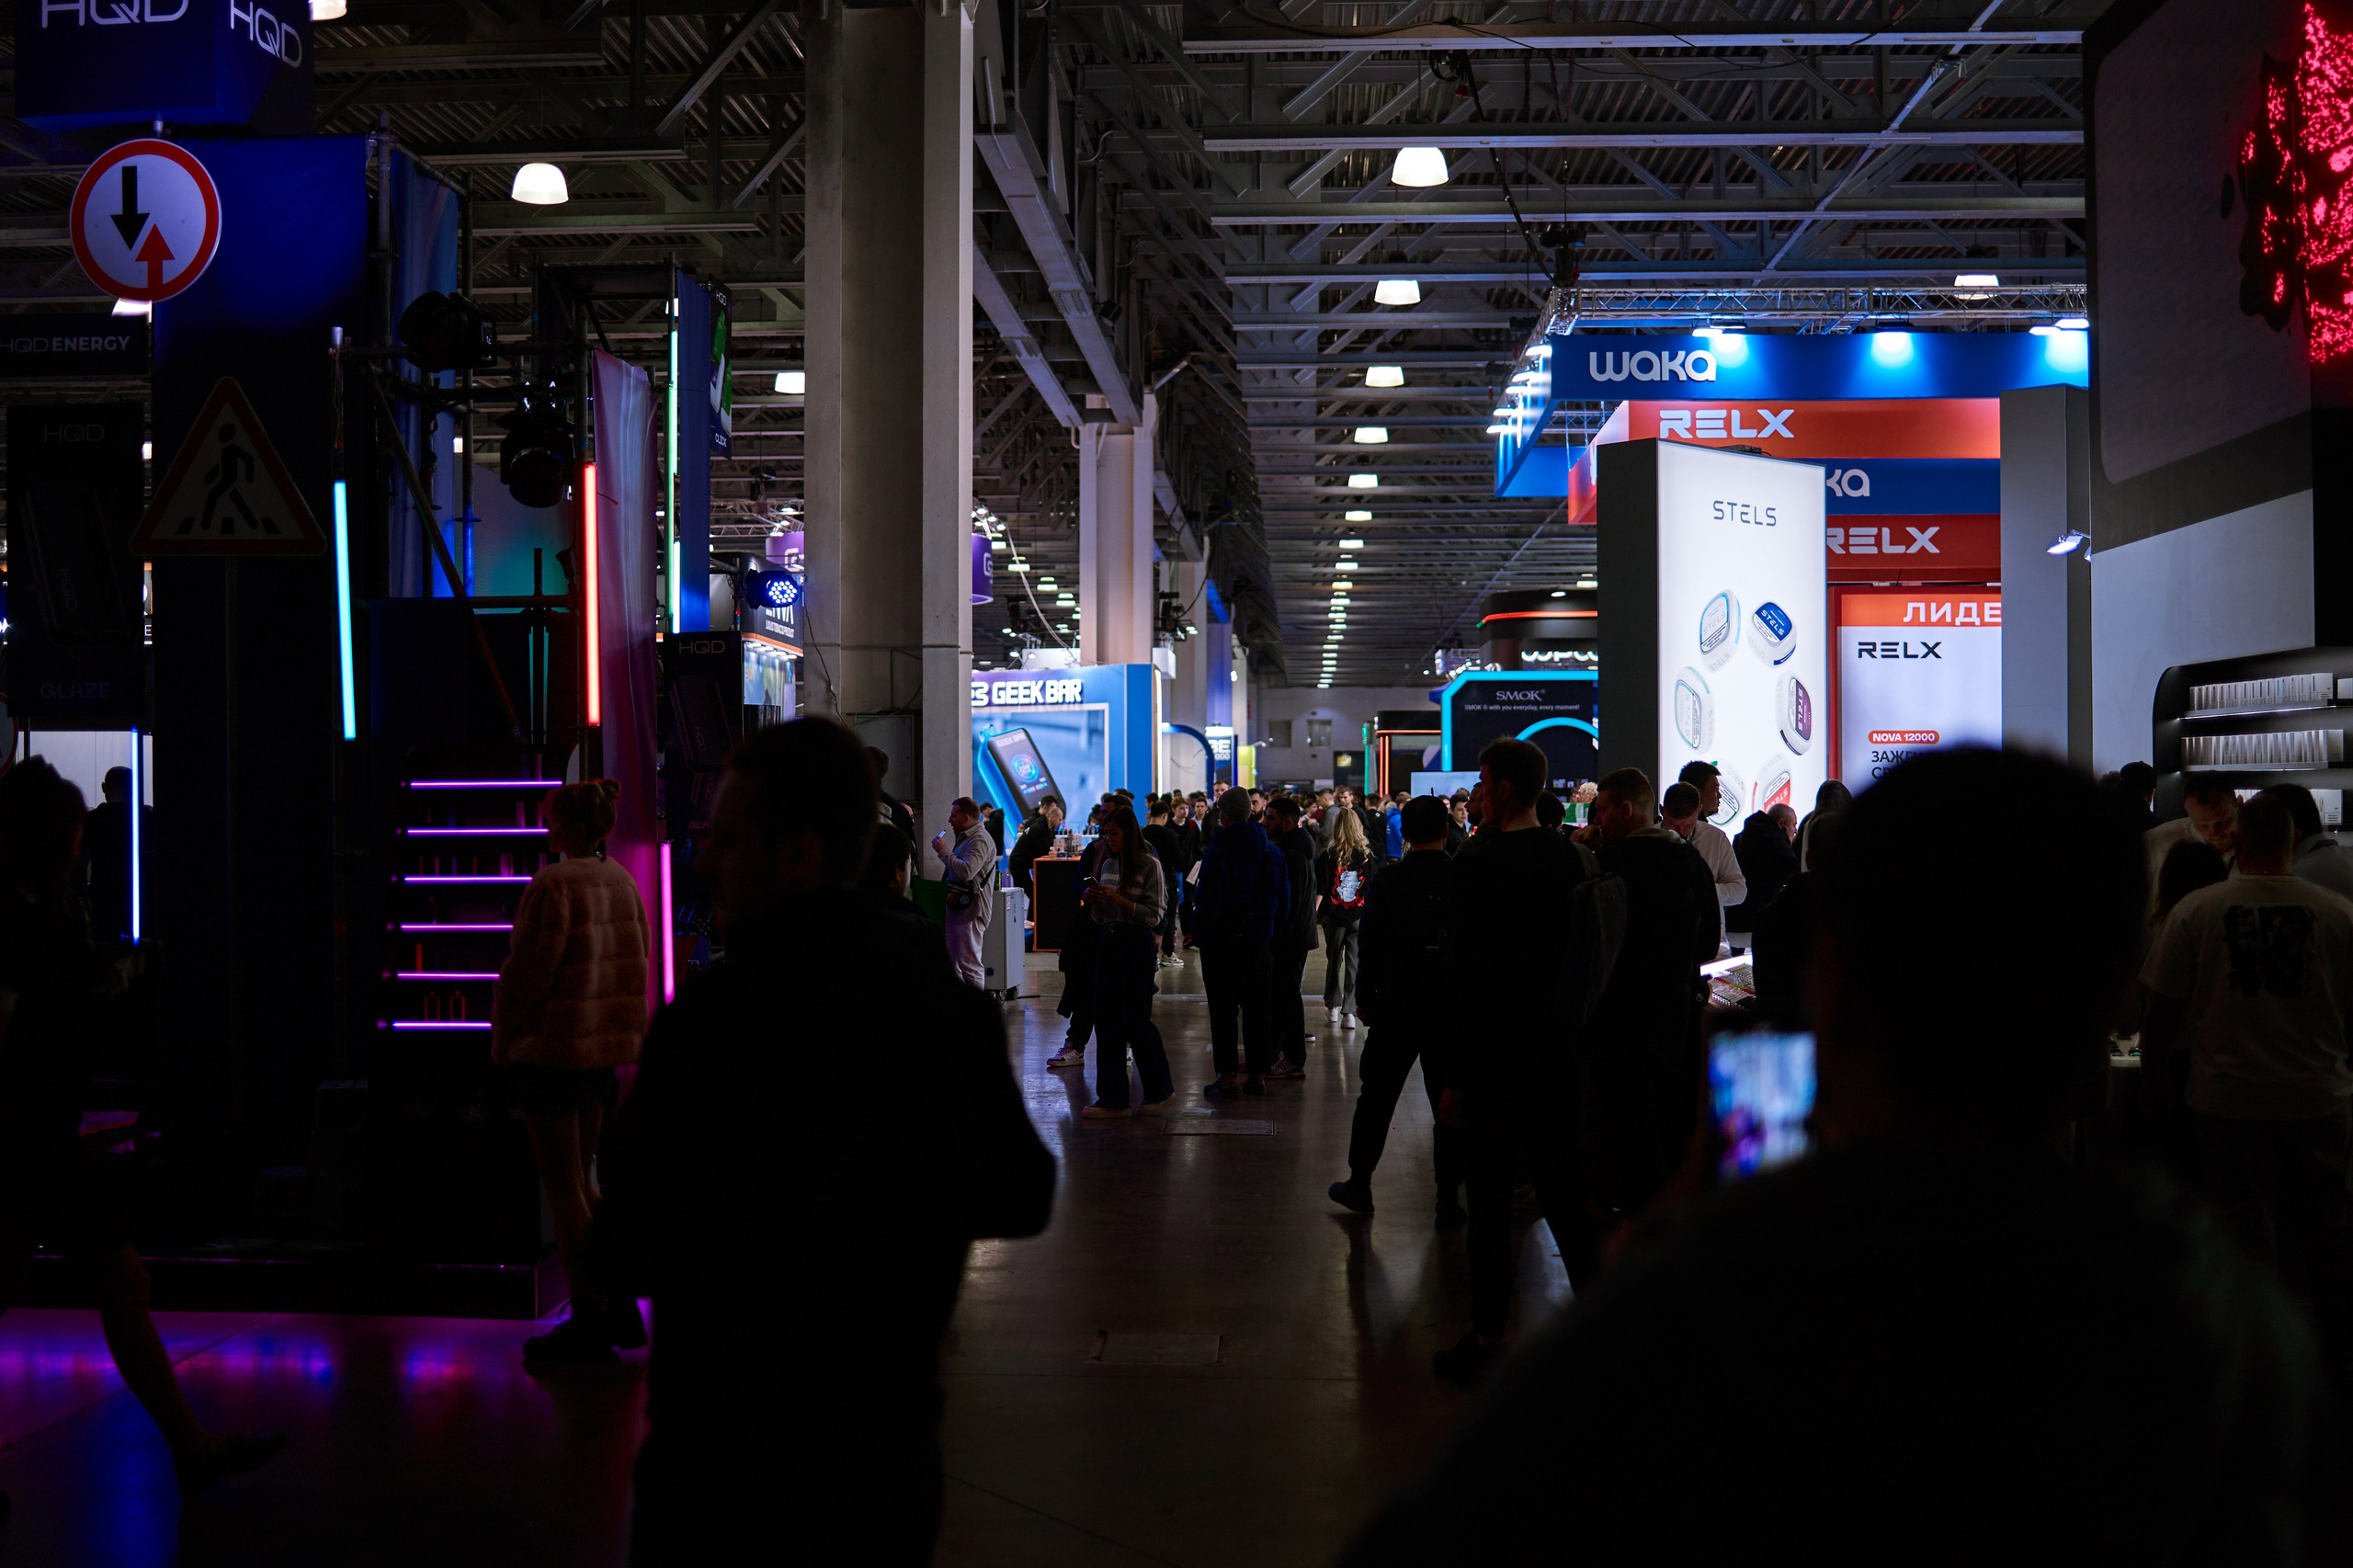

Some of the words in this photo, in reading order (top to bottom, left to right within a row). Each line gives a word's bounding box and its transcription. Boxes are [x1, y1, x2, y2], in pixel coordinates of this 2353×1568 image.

[40, 0, 188, 28] HQD
[230, 0, 302, 69] HQD
[51, 336, 131, 352] ENERGY
[43, 424, 105, 442] HQD
[1659, 409, 1795, 438] RELX
[1713, 500, 1777, 527] STELS
[1826, 527, 1940, 554] RELX
[1761, 609, 1785, 636] STELS
[1903, 602, 2002, 626] ЛИДЕ
[678, 640, 726, 654] HQD
[1858, 642, 1942, 659] RELX
[40, 681, 111, 699] GLAZE
[992, 681, 1045, 705] GEEK
[1045, 679, 1083, 704] BAR
[1872, 733, 1902, 742] NOVA
[1904, 733, 1936, 742] 12000
